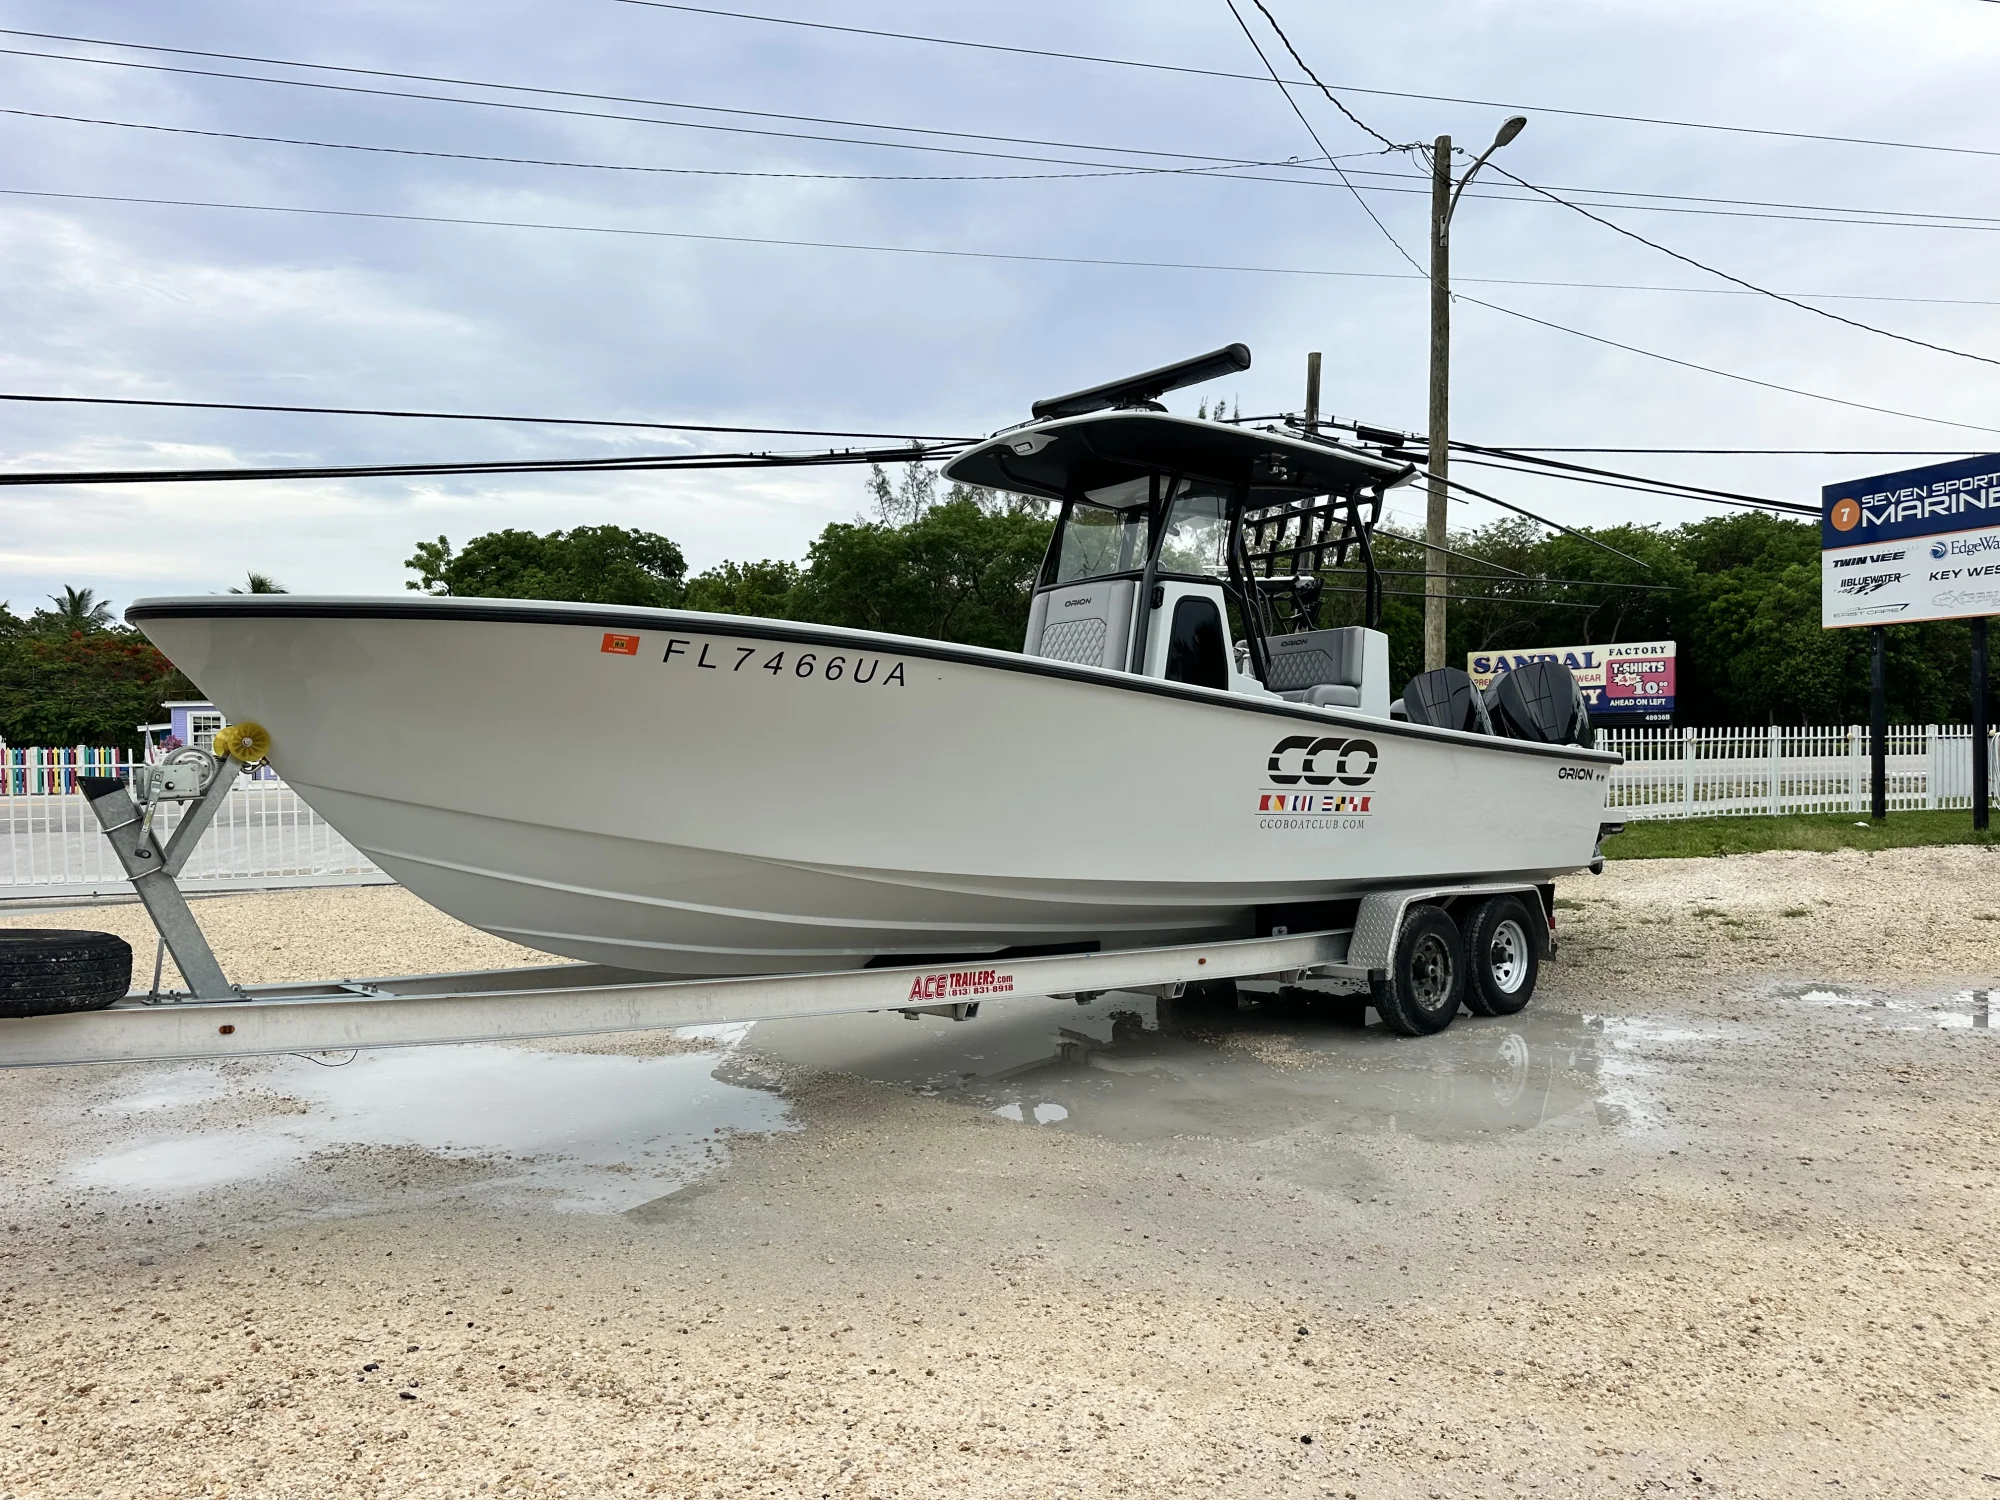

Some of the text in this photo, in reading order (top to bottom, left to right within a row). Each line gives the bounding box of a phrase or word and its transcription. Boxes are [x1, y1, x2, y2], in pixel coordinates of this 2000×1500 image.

[1861, 485, 1926, 508] SEVEN
[1840, 507, 1850, 522] 7
[1832, 551, 1905, 568] TWIN VEE
[1929, 569, 1962, 581] KEY
[1064, 598, 1092, 607] ORION
[1833, 607, 1900, 618] EAST CAPE
[1280, 639, 1308, 647] ORION
[1608, 646, 1666, 656] FACTORY
[1612, 661, 1665, 674] T-SHIRTS
[1574, 674, 1601, 682] WEAR
[1581, 689, 1602, 705] Y
[1268, 735, 1378, 786] CCO
[1558, 766, 1594, 780] ORION
[1260, 820, 1365, 830] CCOBOATCLUB.COM
[908, 974, 948, 1001] ACE
[949, 984, 1014, 996] (813) 831-8918
